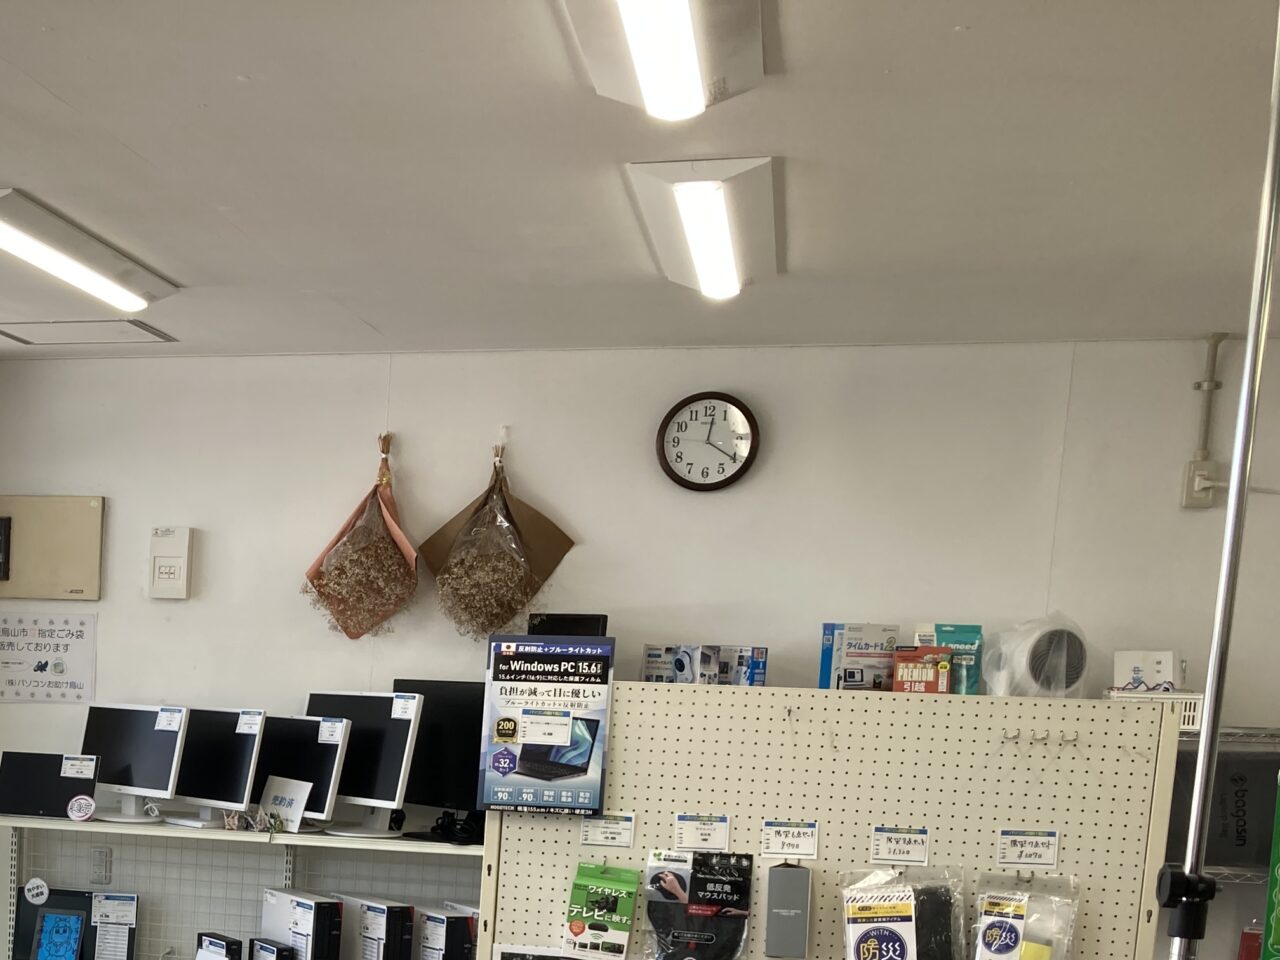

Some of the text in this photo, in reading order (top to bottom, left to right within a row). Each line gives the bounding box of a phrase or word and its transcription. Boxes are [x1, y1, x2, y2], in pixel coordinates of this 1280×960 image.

[689, 410, 699, 421] 11
[704, 405, 716, 417] 12
[676, 421, 688, 433] 10
[672, 436, 680, 448] 9
[675, 451, 683, 463] 8
[686, 463, 693, 474] 7
[701, 467, 709, 479] 6
[717, 463, 725, 474] 5
[37, 628, 85, 640] 指定ごみ袋
[846, 642, 880, 650] タイムカード
[510, 660, 560, 672] Windows
[560, 662, 576, 672] PC
[578, 662, 597, 673] 15.6
[499, 686, 601, 699] 負担が減って目に優しい
[498, 721, 515, 730] 200
[498, 792, 509, 800] 90
[522, 793, 533, 801] 90
[588, 885, 633, 898] ワイヤレスで
[706, 882, 732, 893] 低反発
[697, 891, 740, 901] マウスパッド
[569, 904, 632, 925] テレビに映す。
[869, 929, 890, 937] WITH
